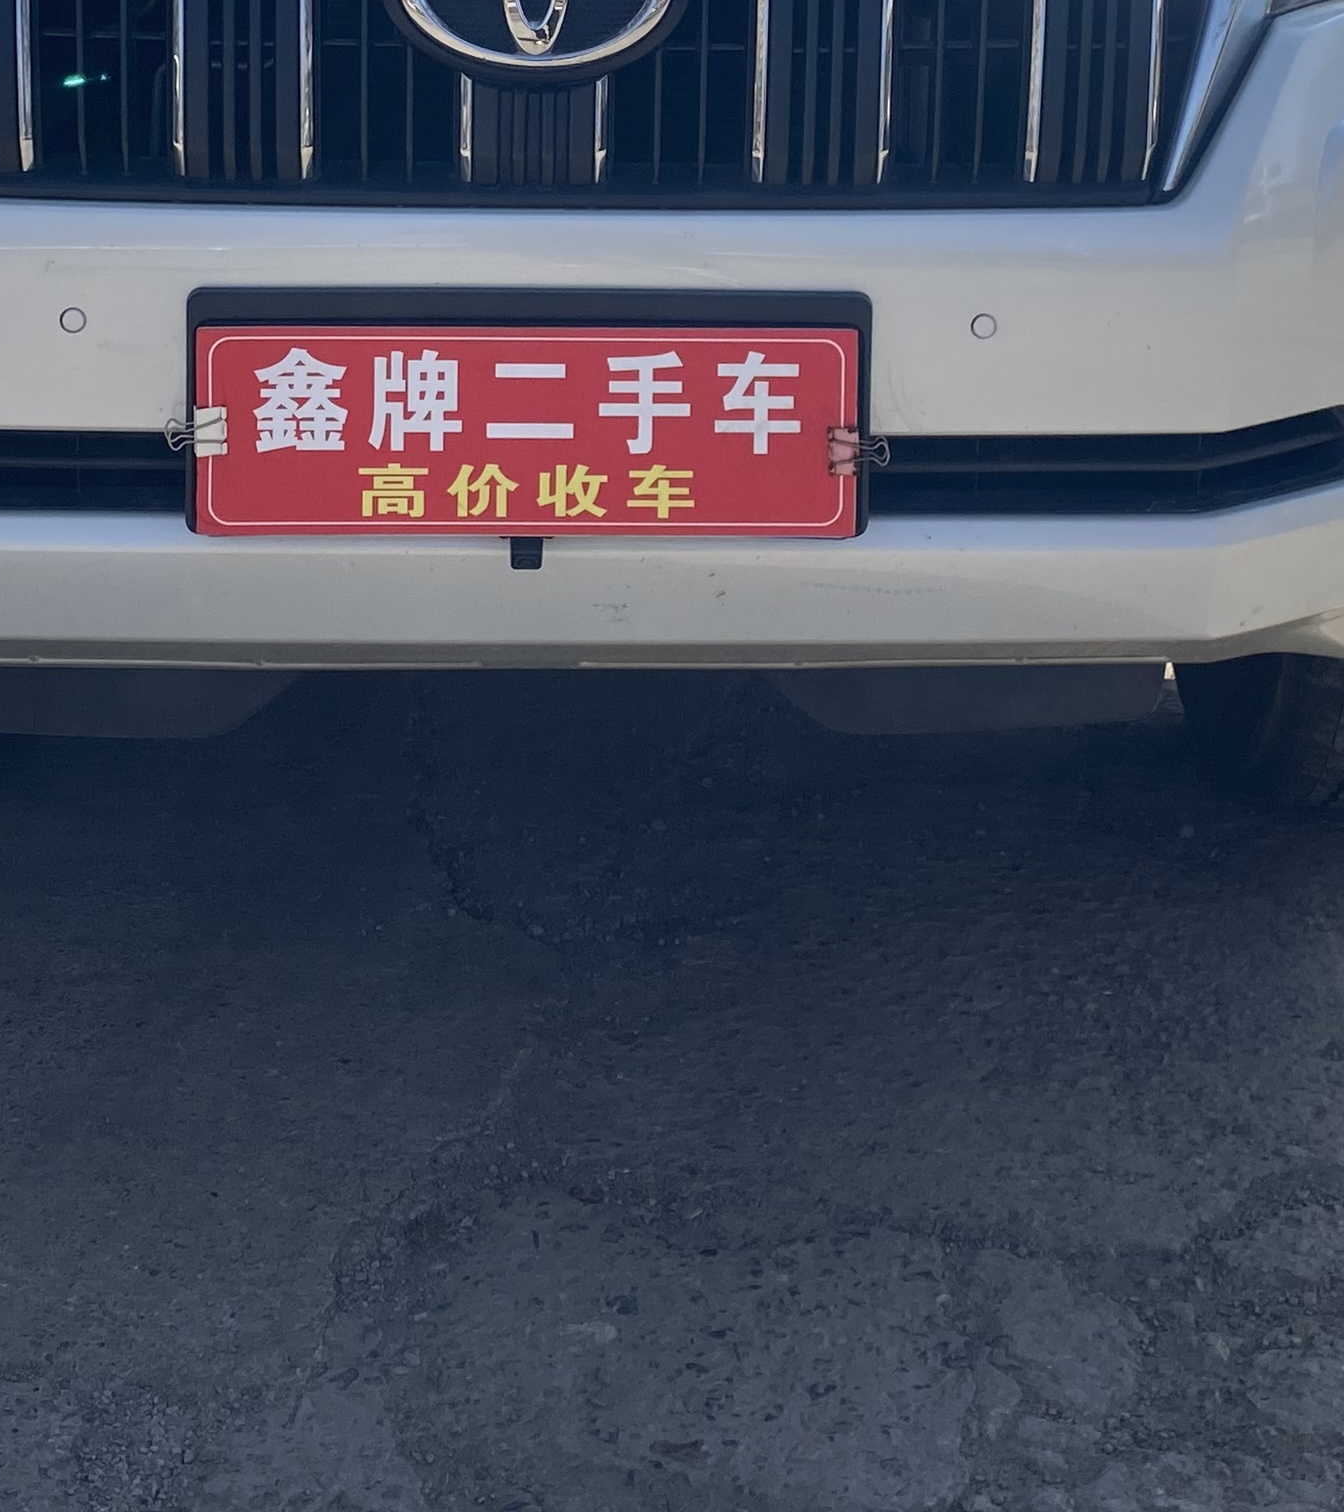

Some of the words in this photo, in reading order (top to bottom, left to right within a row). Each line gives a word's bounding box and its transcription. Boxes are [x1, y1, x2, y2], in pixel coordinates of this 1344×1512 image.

[252, 347, 803, 456] 鑫牌二手车
[357, 463, 696, 520] 高价收车
